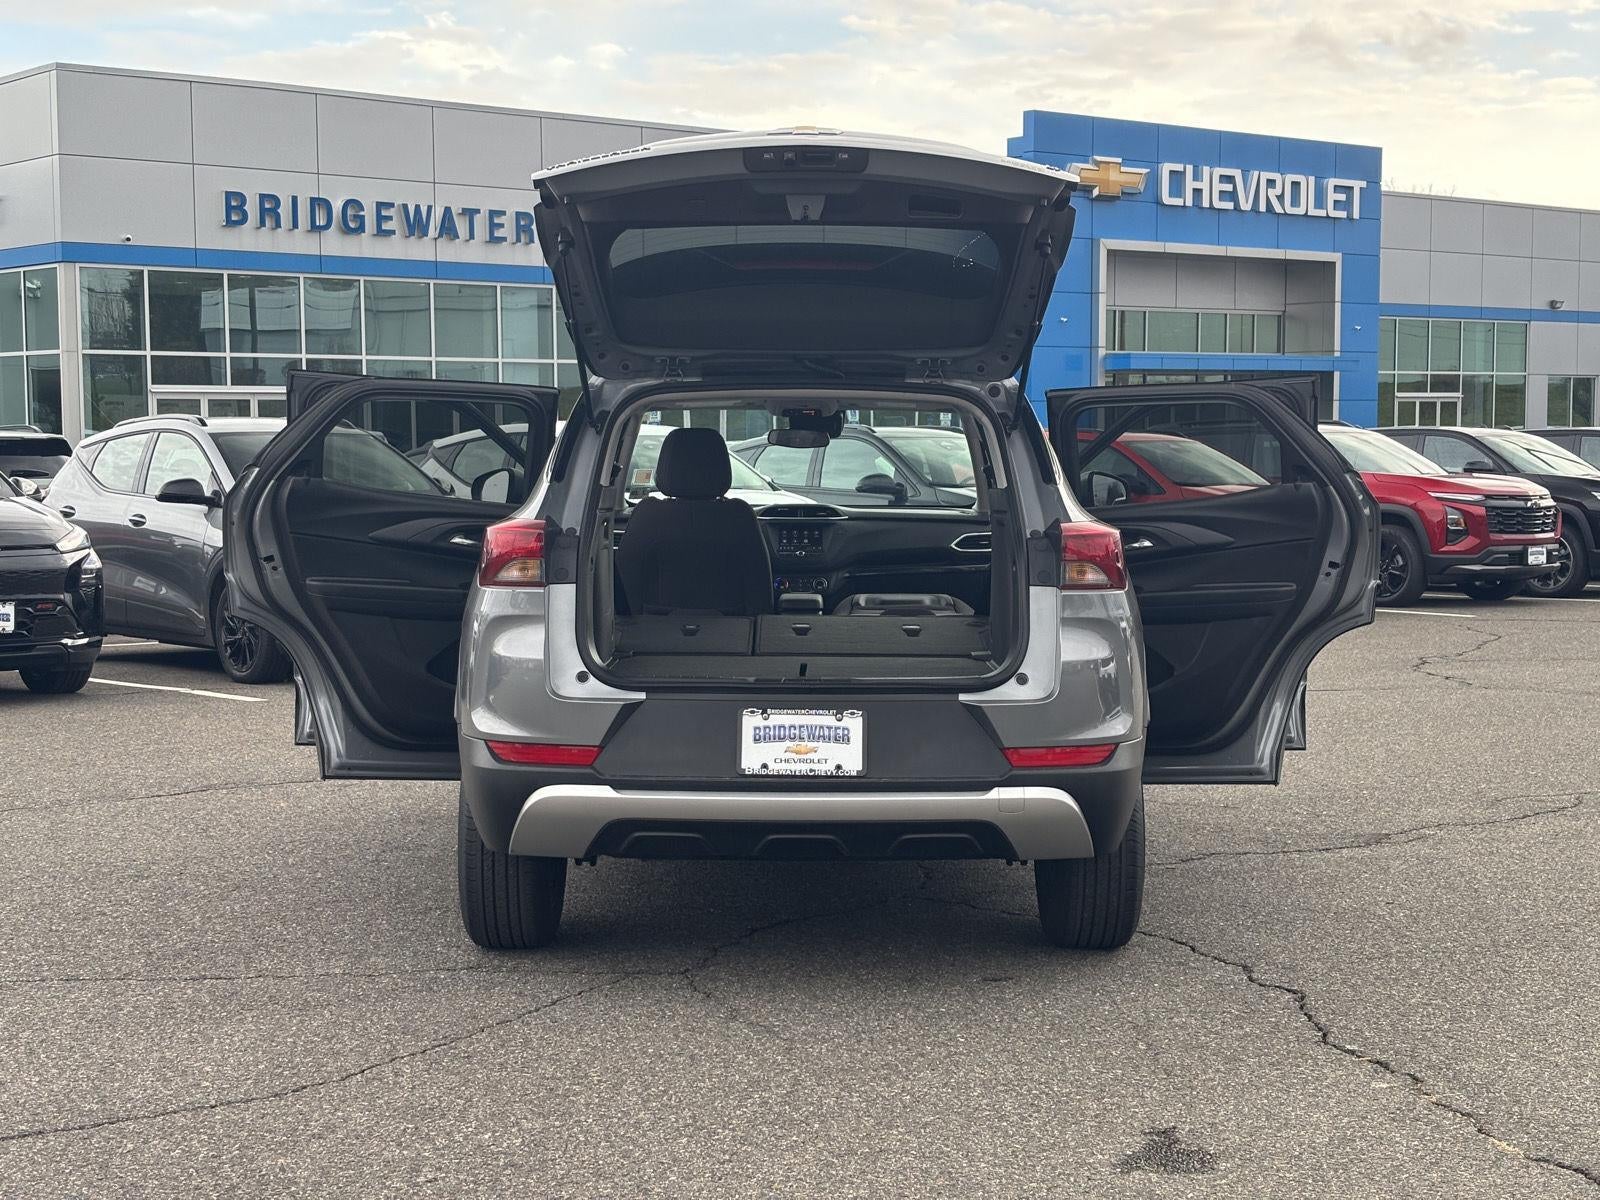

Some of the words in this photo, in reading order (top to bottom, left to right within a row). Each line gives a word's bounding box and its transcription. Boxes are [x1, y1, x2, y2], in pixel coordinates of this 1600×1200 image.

[1159, 162, 1367, 220] CHEVROLET
[222, 190, 536, 245] BRIDGEWATER
[767, 708, 837, 716] BRIDGEWATERCHEVROLET
[752, 723, 852, 745] BRIDGEWATER
[774, 757, 829, 765] CHEVROLET
